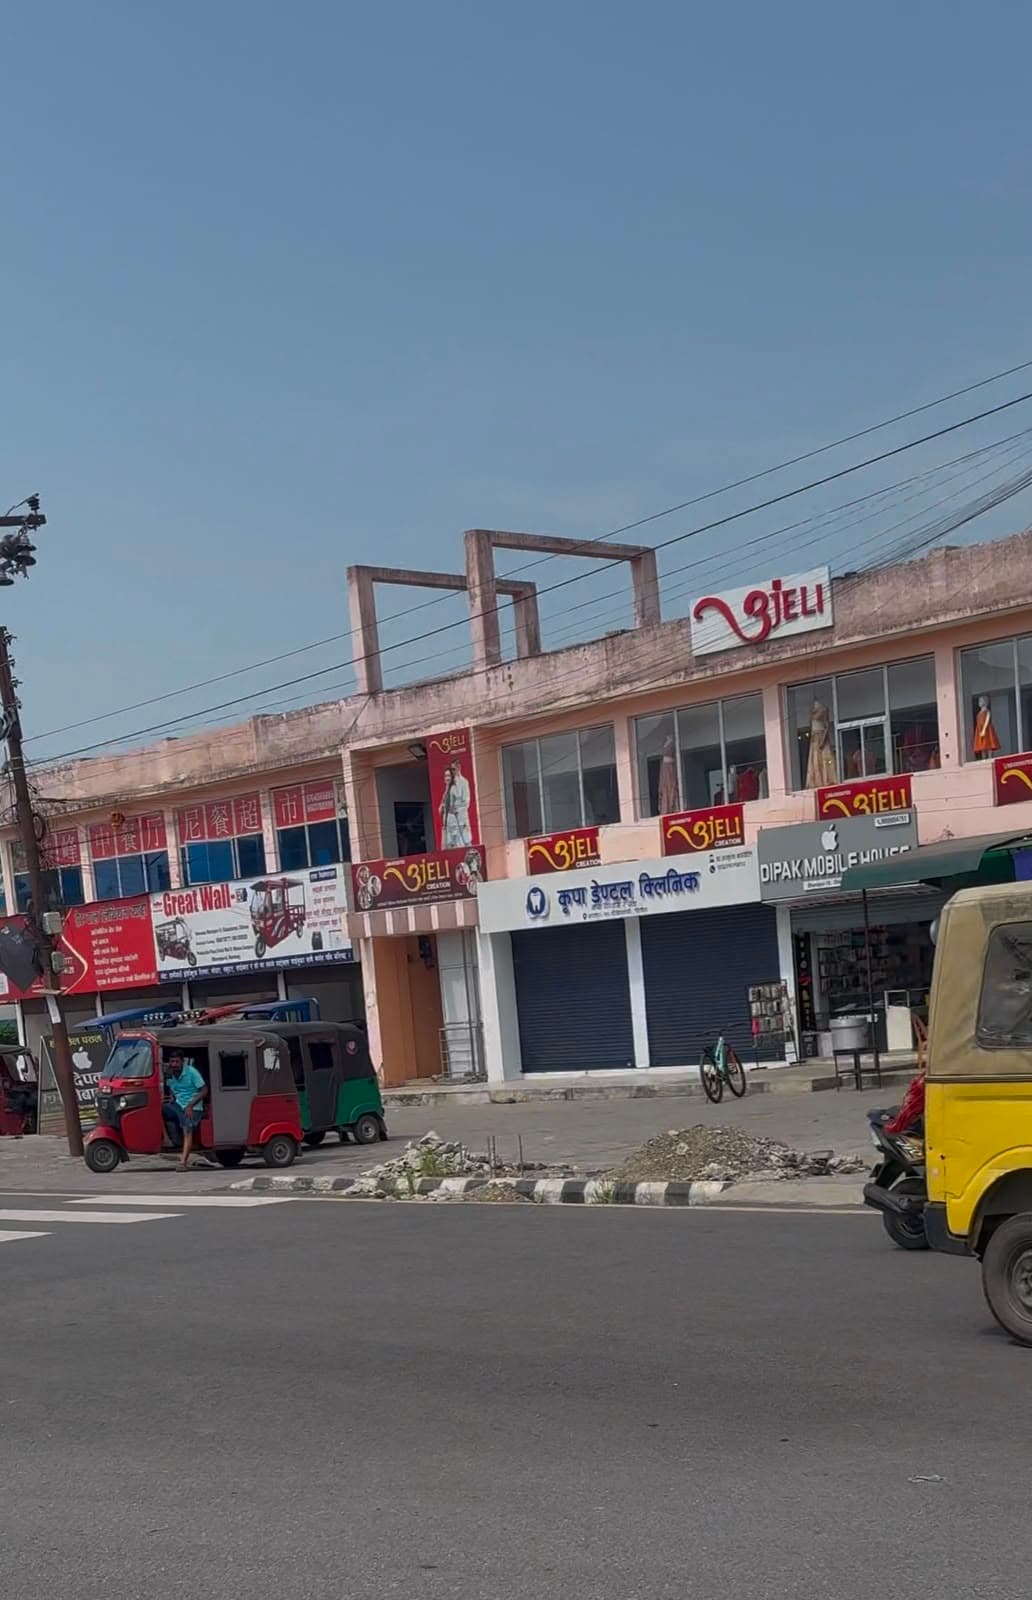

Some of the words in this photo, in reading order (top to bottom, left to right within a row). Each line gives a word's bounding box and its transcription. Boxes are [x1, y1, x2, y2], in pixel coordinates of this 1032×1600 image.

[760, 856, 803, 883] DIPAK
[163, 890, 199, 917] Great
[199, 883, 232, 912] Wall
